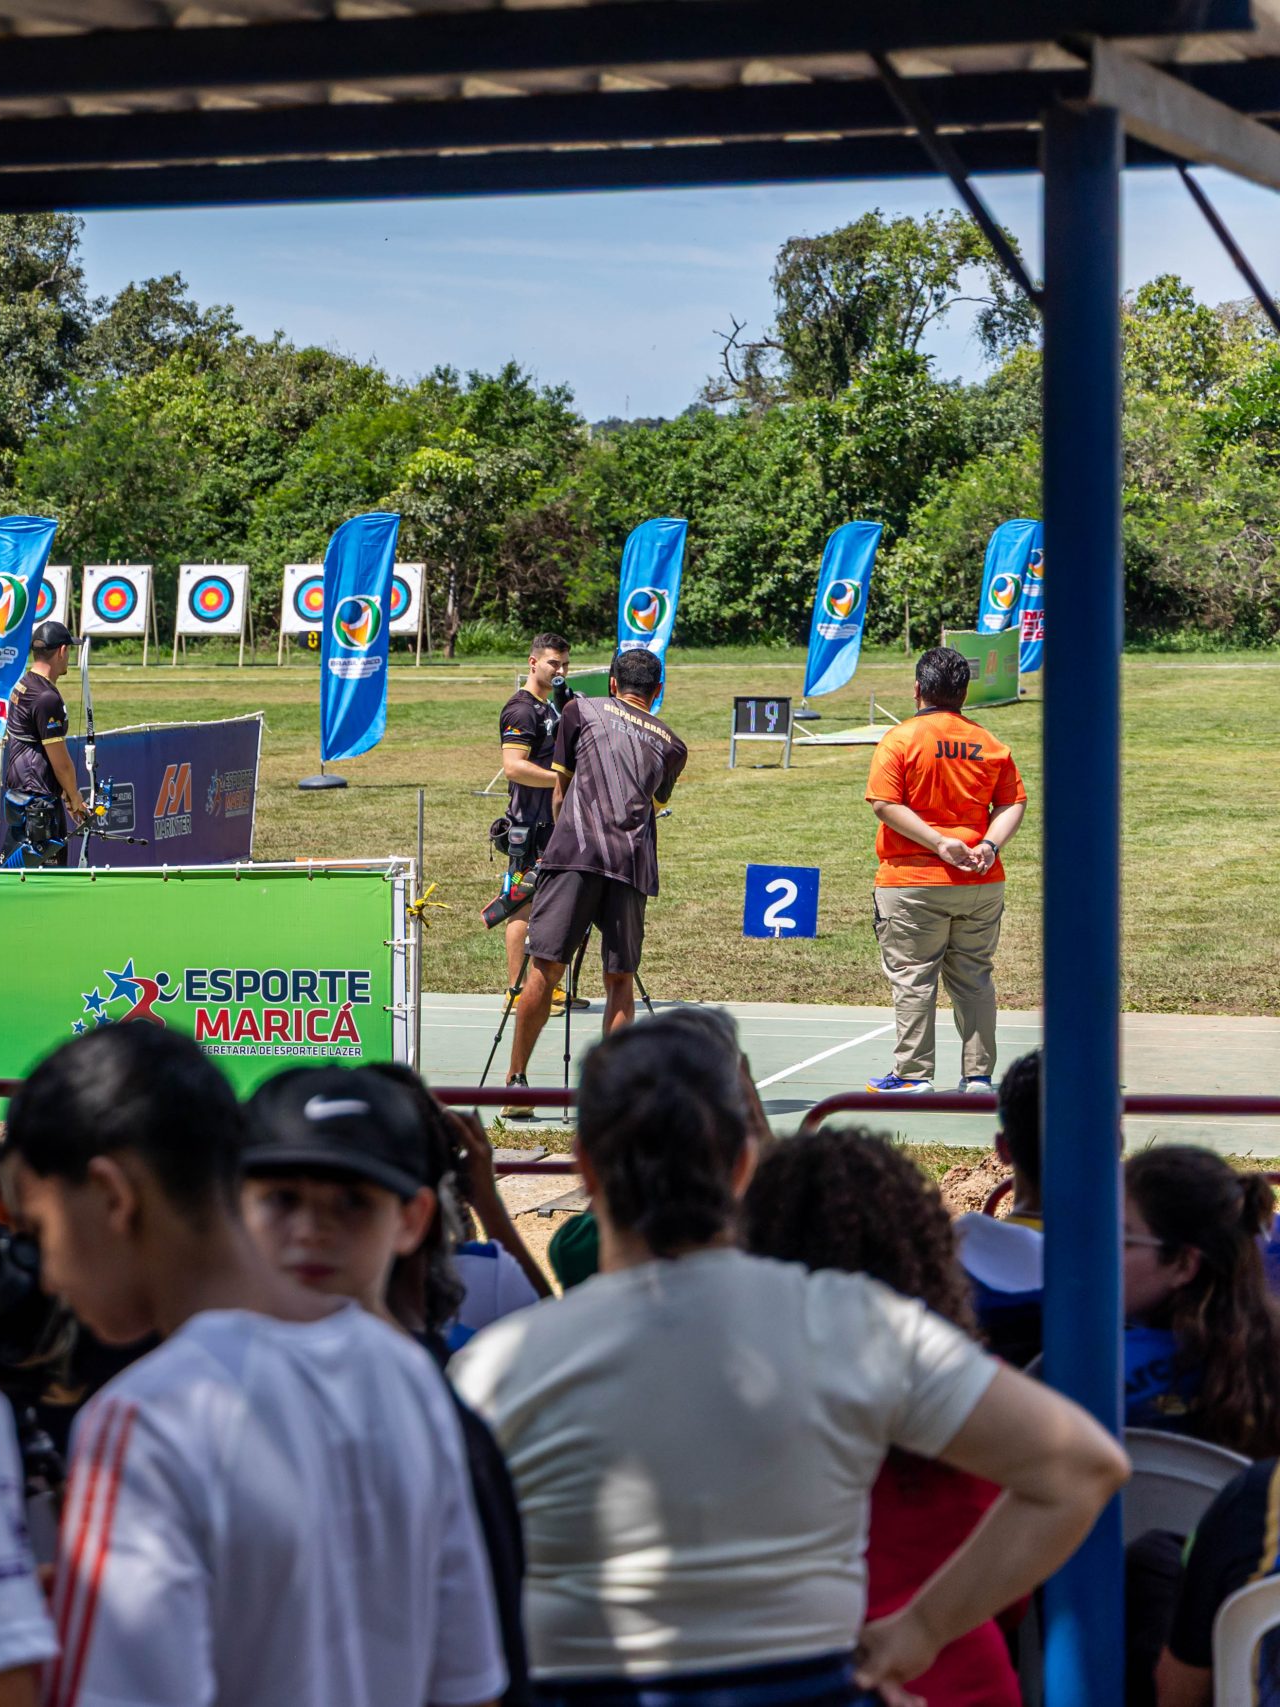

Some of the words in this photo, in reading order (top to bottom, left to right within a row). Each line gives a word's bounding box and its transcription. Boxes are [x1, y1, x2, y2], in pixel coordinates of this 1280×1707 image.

[603, 703, 643, 727] DISPARA
[643, 721, 672, 744] BRASIL
[746, 700, 779, 733] 19
[935, 740, 984, 762] JUIZ
[764, 878, 798, 929] 2
[185, 969, 371, 1004] ESPORTE
[195, 1001, 361, 1043] MARICÁ
[201, 1045, 257, 1056] ECRETARIA
[259, 1046, 273, 1056] DE
[274, 1046, 319, 1056] ESPORTE
[320, 1047, 327, 1056] E
[329, 1047, 362, 1057] LAZER
